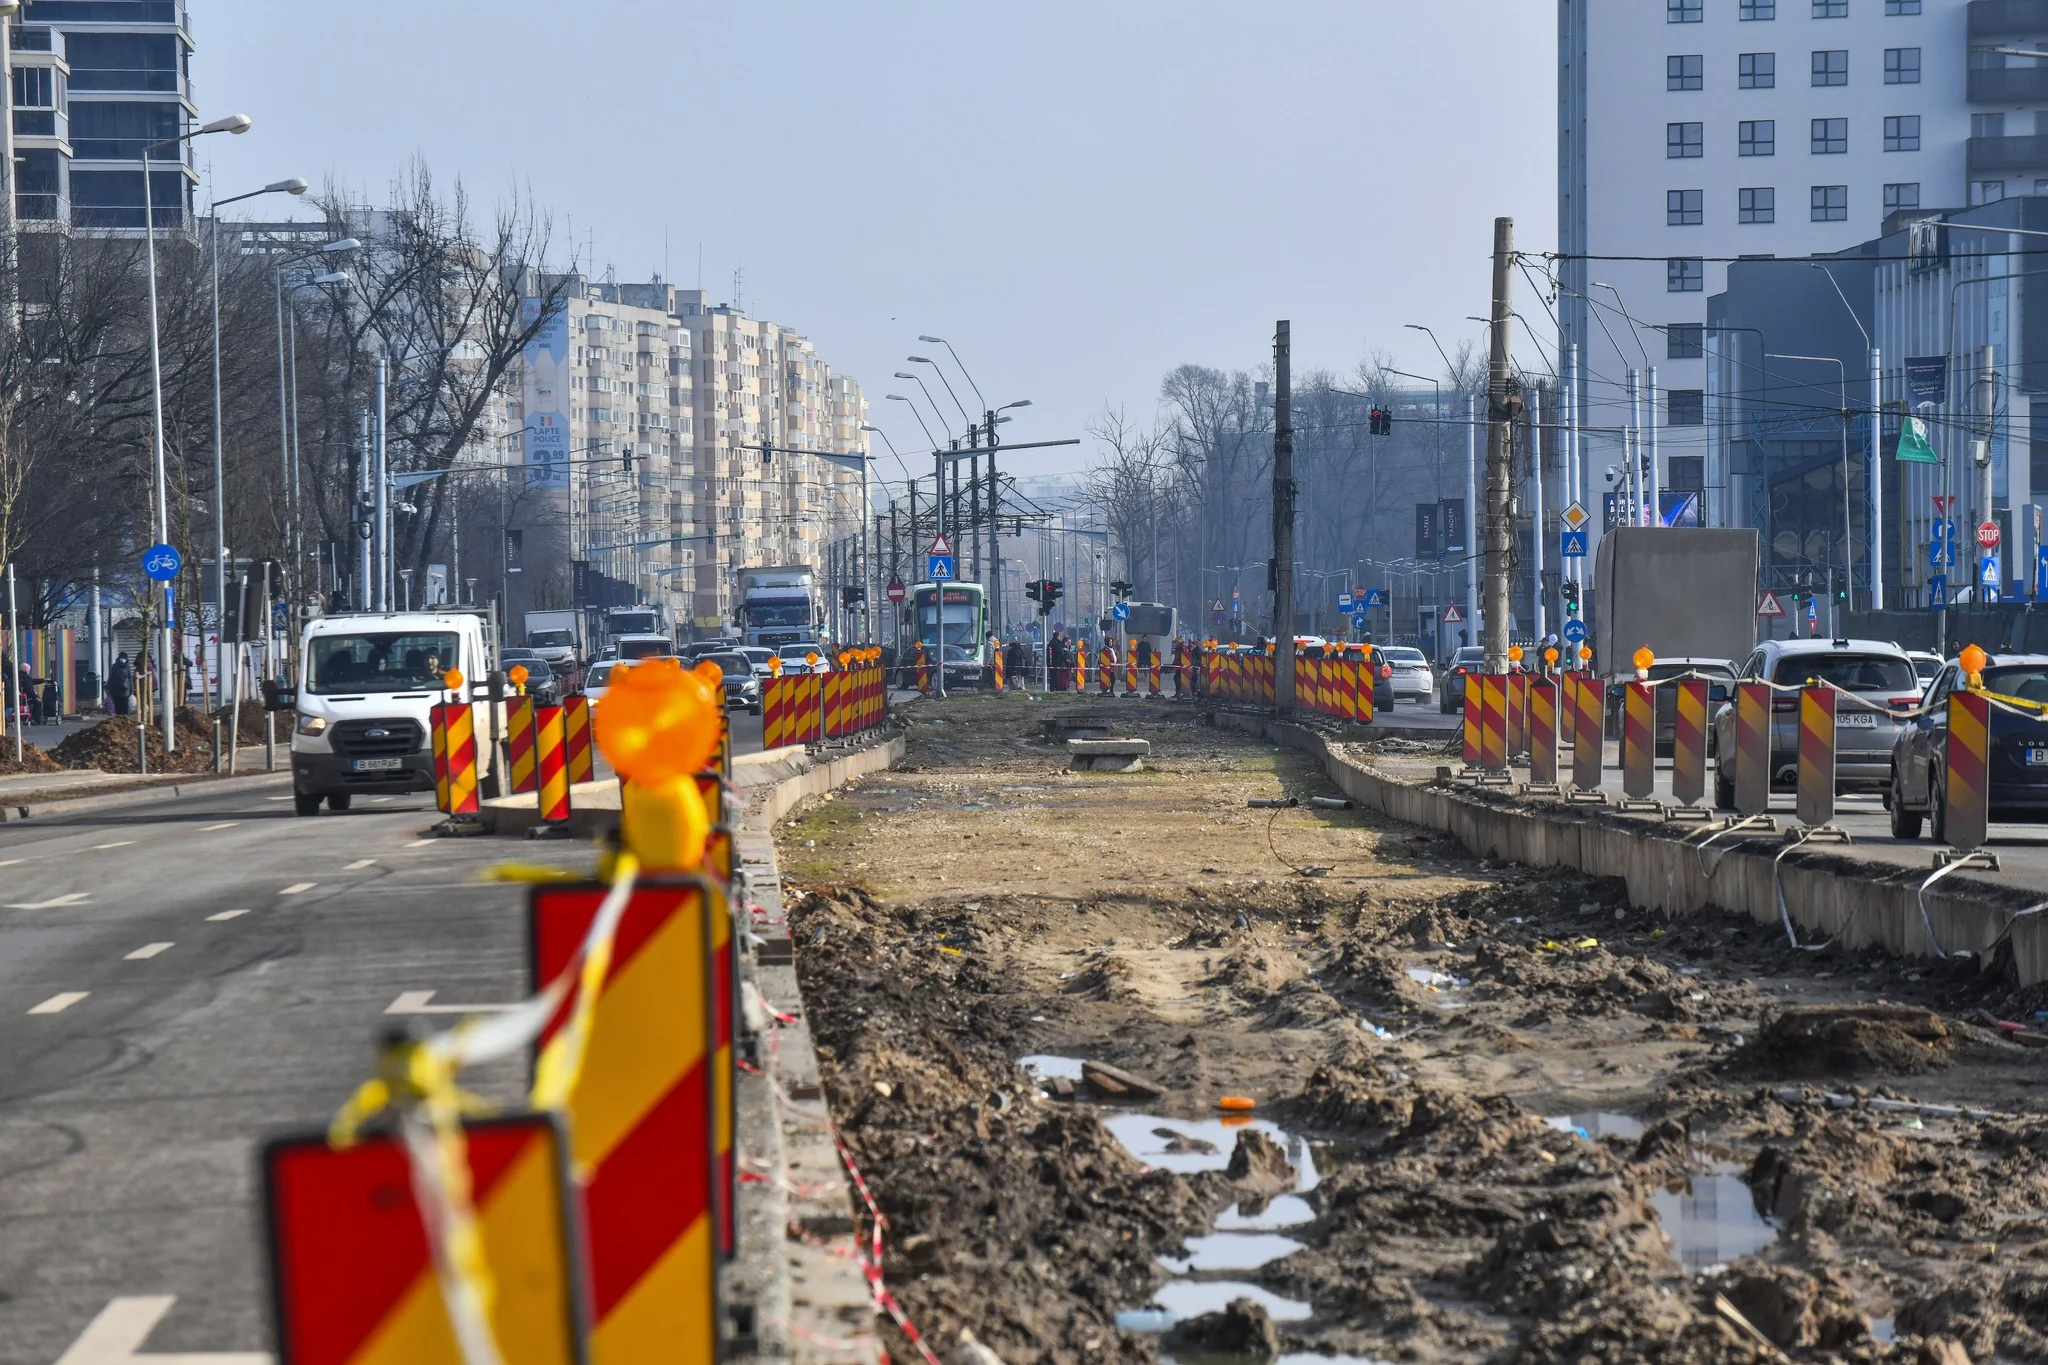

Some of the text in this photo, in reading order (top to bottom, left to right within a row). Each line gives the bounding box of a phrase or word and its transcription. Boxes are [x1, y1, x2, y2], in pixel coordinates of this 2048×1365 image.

[1978, 529, 2000, 541] STOP
[1836, 714, 1873, 724] 105 KGA
